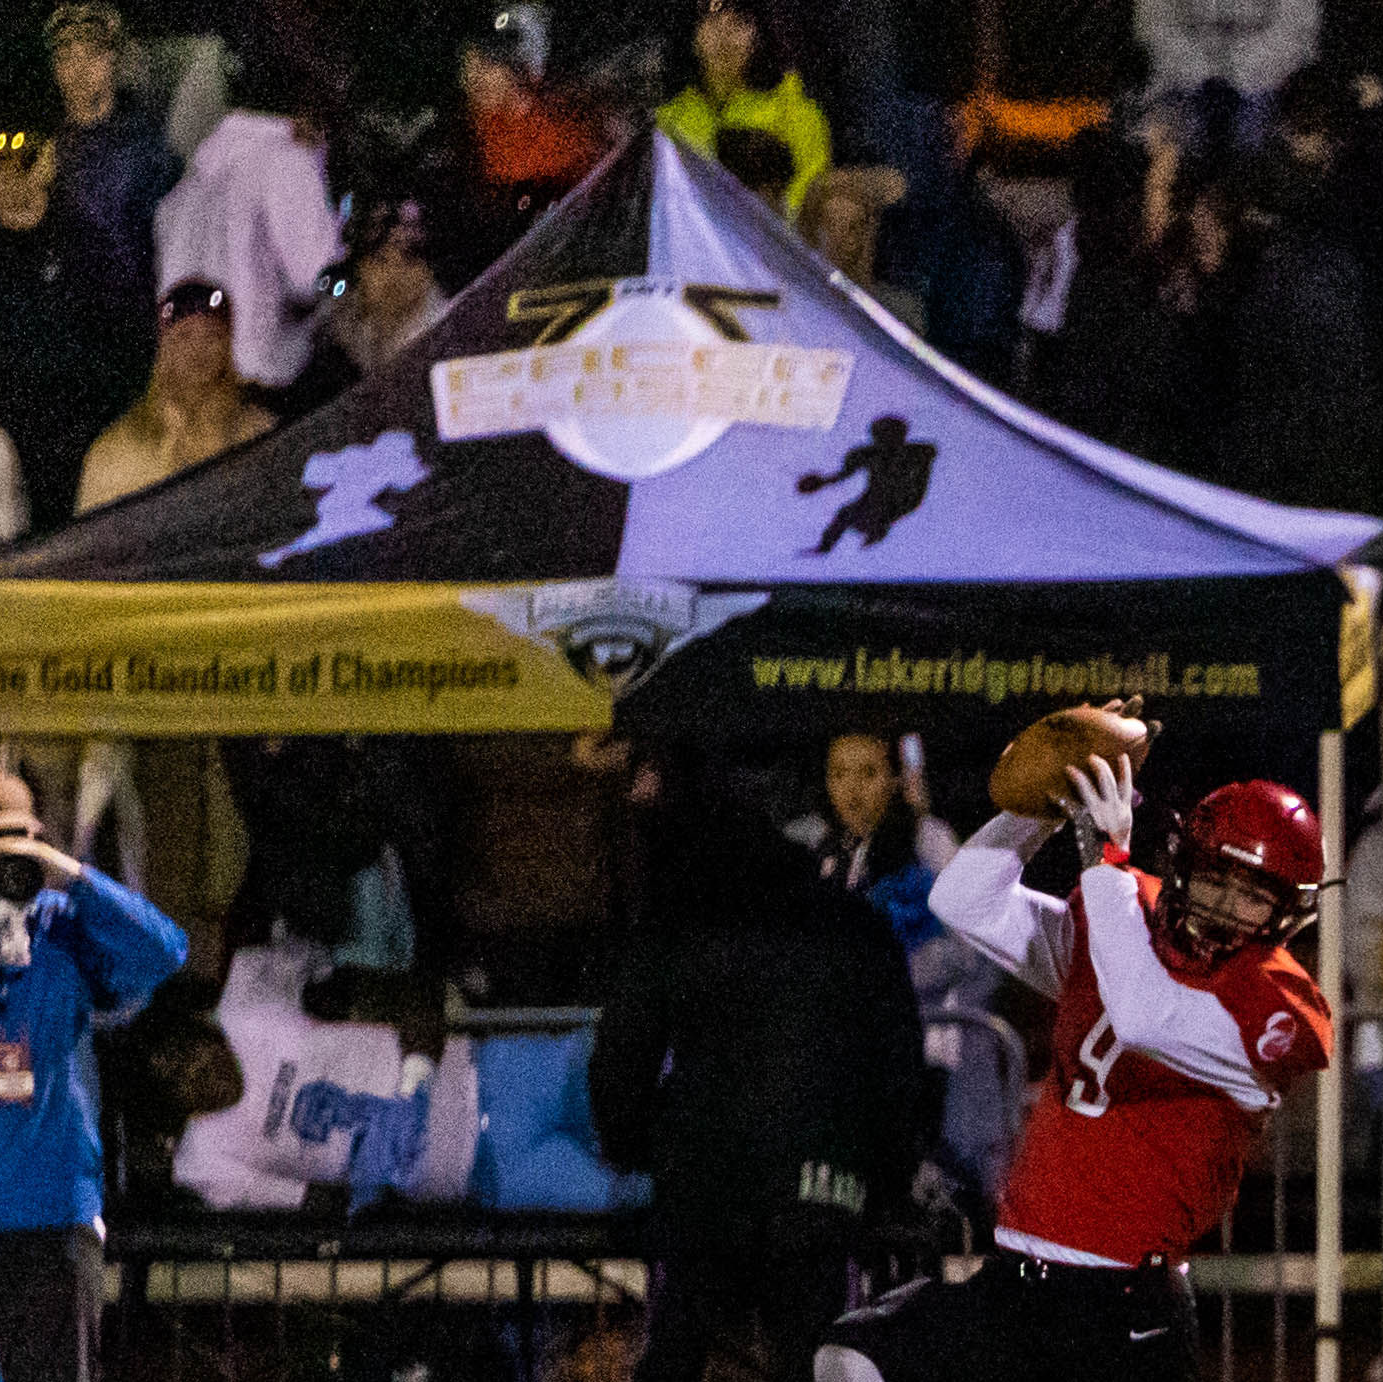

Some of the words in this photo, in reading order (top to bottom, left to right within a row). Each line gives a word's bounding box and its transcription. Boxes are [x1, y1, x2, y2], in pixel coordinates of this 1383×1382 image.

[40, 654, 114, 693] Gold
[125, 654, 276, 694] Standard
[287, 654, 321, 696] of
[330, 652, 518, 702] Champions
[752, 647, 1261, 702] www.lakeridgefootball.com
[1067, 1008, 1123, 1118] 9
